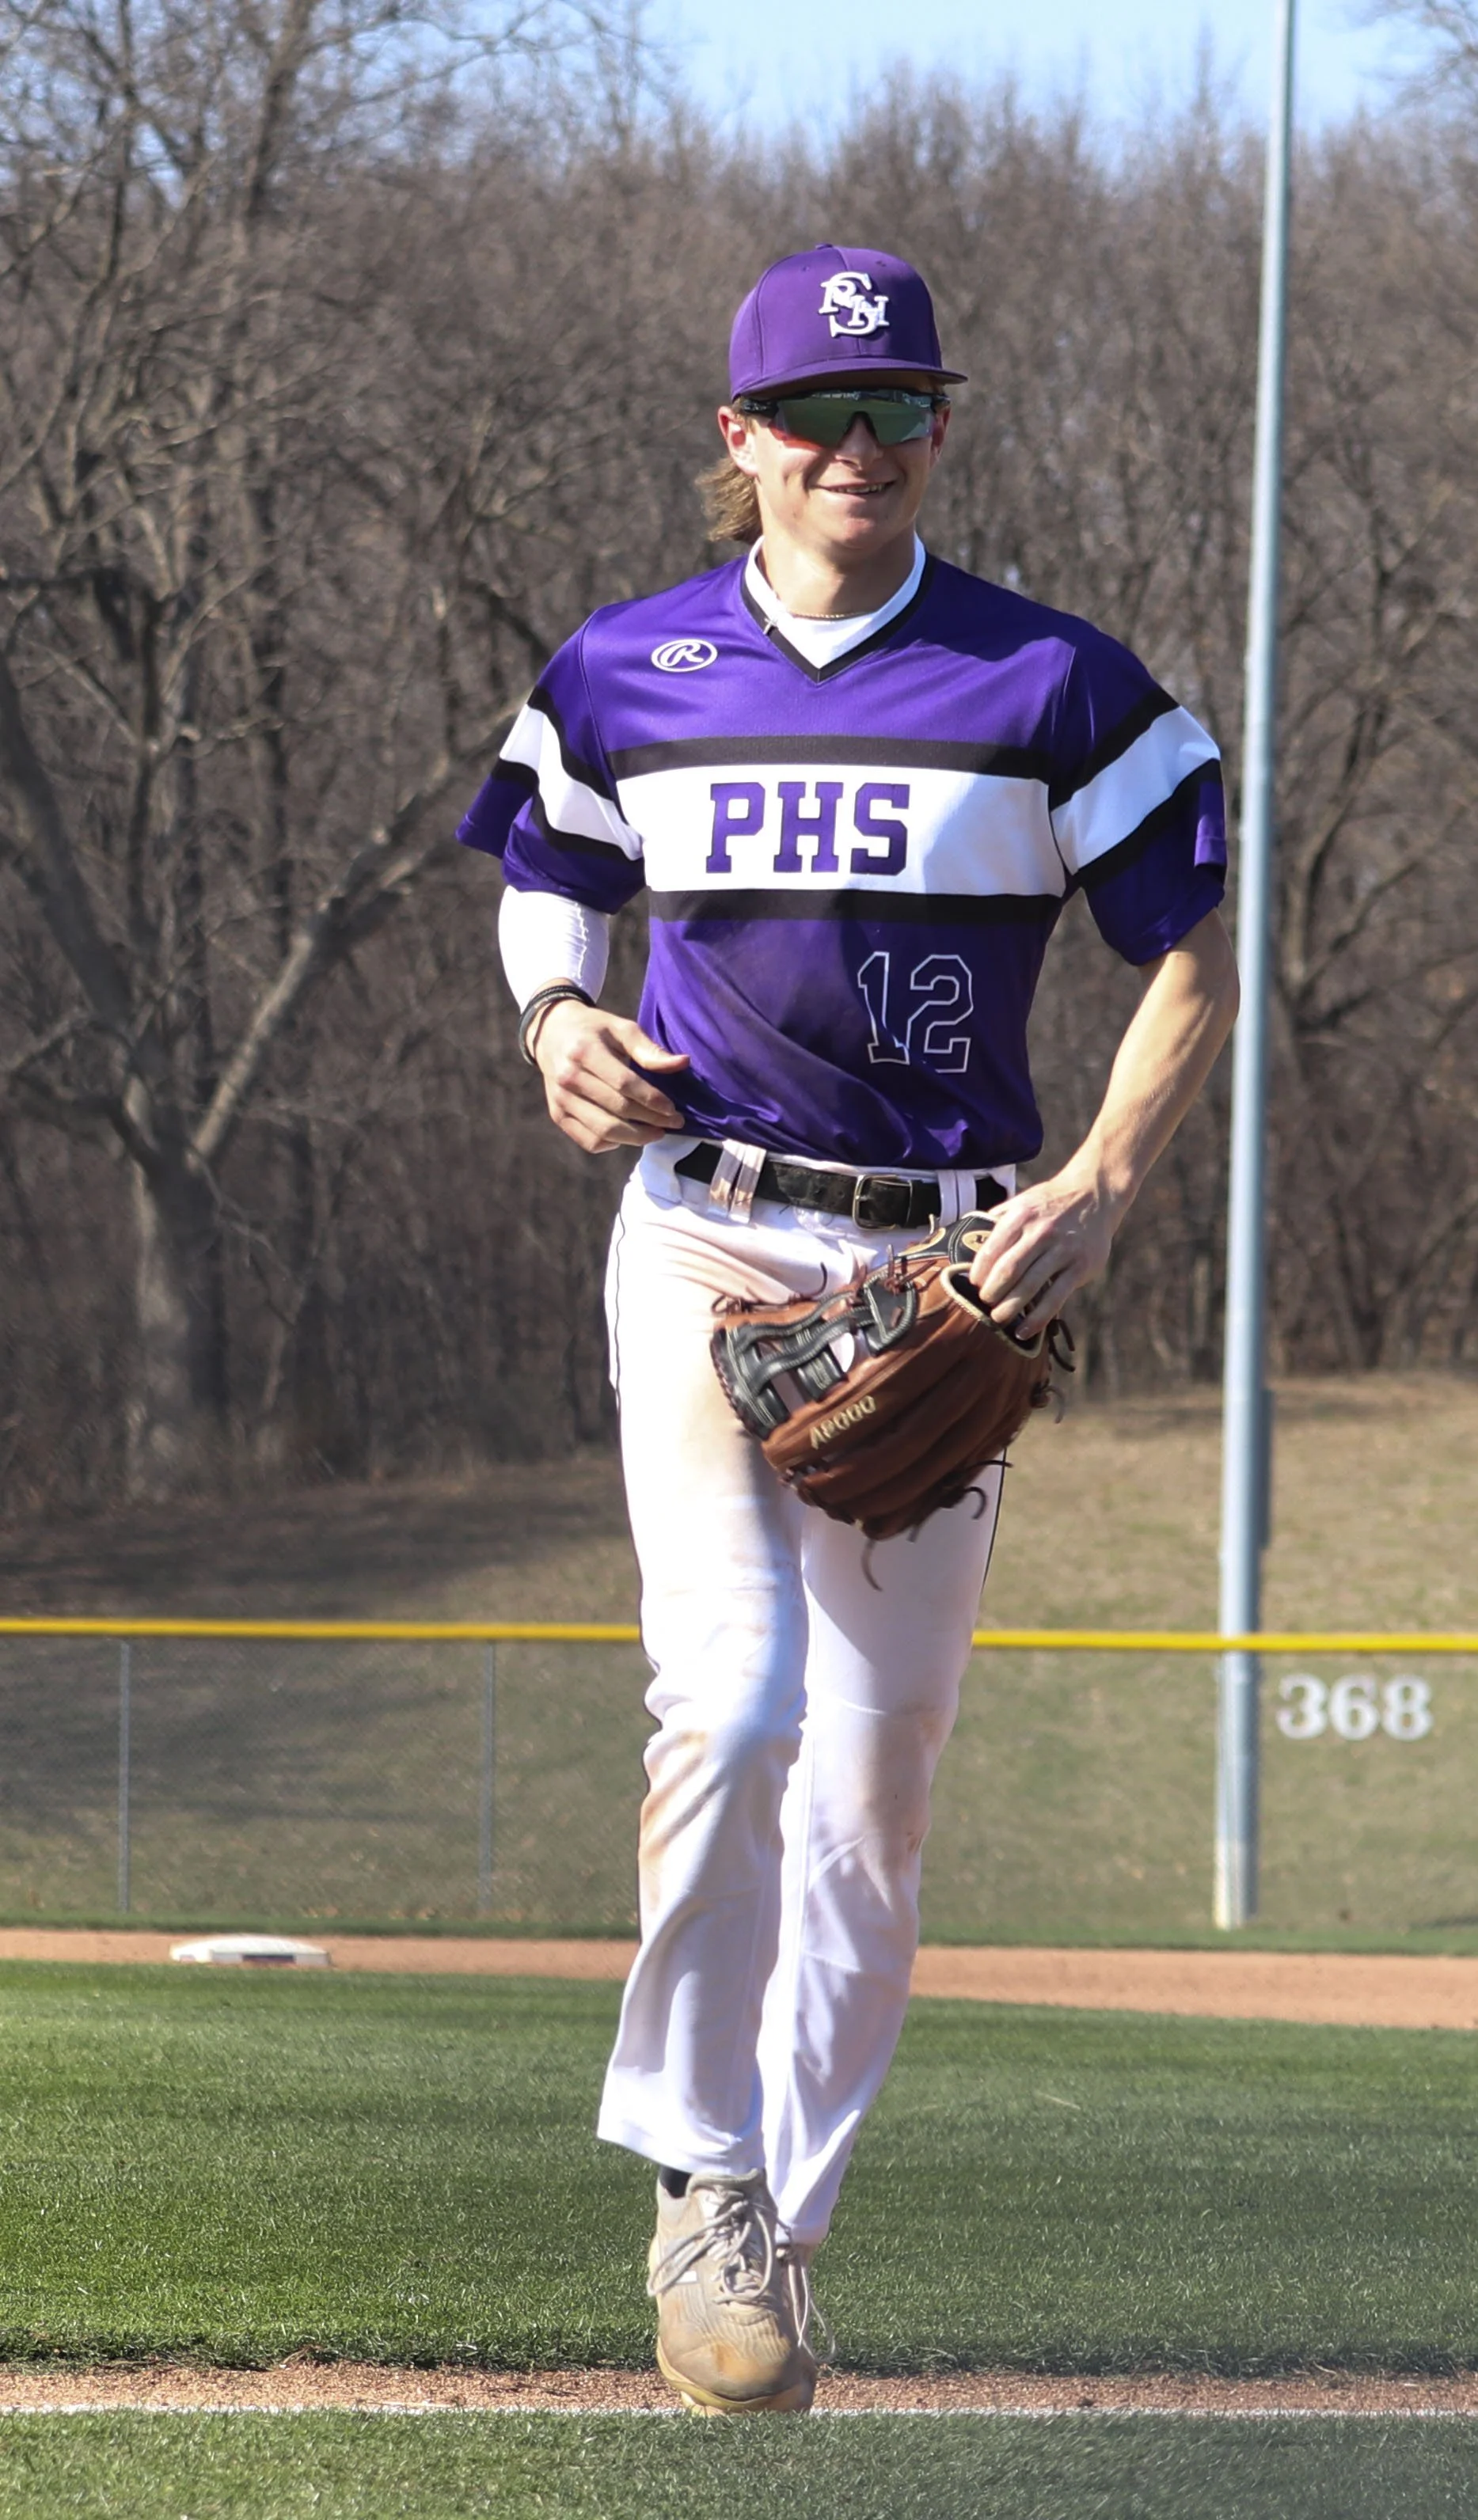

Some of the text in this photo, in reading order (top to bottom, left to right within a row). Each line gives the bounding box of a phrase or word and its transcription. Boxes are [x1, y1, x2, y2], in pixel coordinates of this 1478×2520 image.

[705, 780, 910, 876] PHS
[857, 951, 974, 1073] 12
[1275, 1673, 1434, 1741] 368
